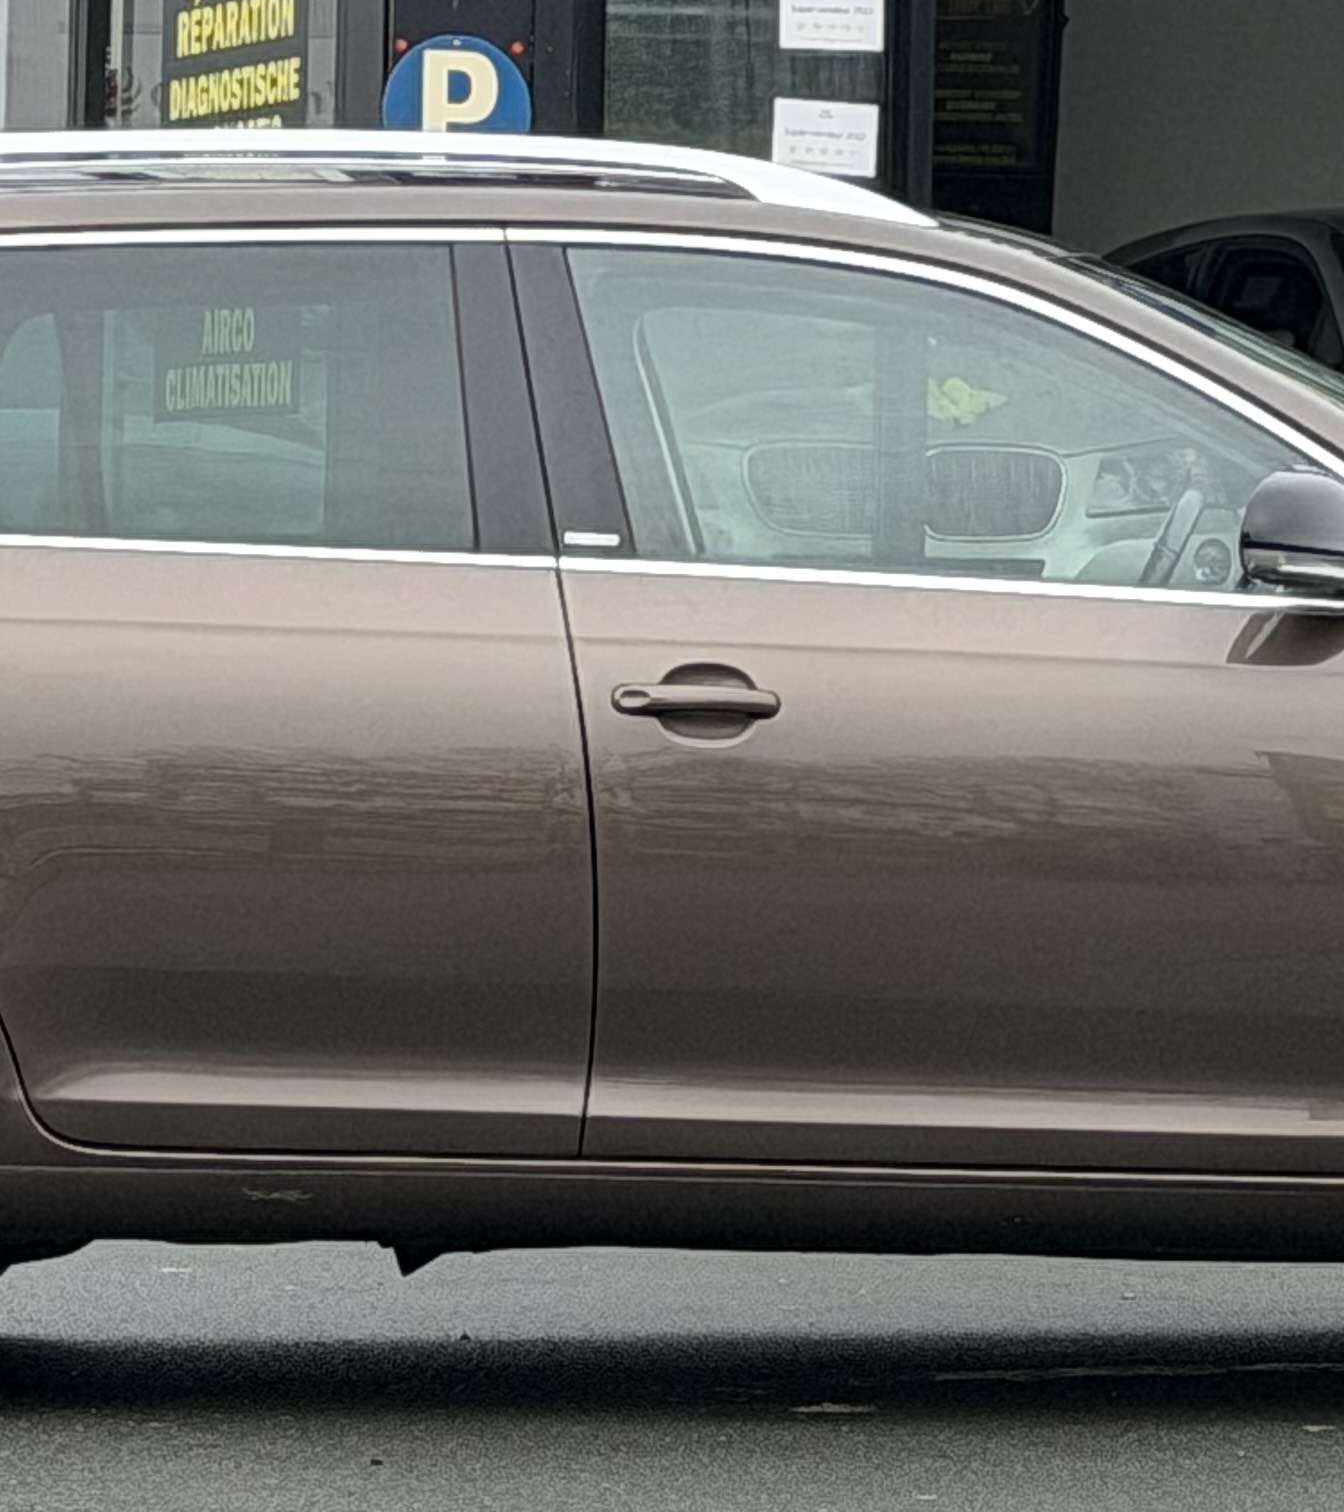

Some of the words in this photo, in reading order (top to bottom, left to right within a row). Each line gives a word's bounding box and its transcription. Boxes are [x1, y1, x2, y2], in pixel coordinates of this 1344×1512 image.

[169, 56, 301, 122] DIAGNOSTISCHE
[422, 48, 499, 132] P
[202, 306, 256, 354] AIRCO
[165, 359, 292, 412] CLIMATISATION
